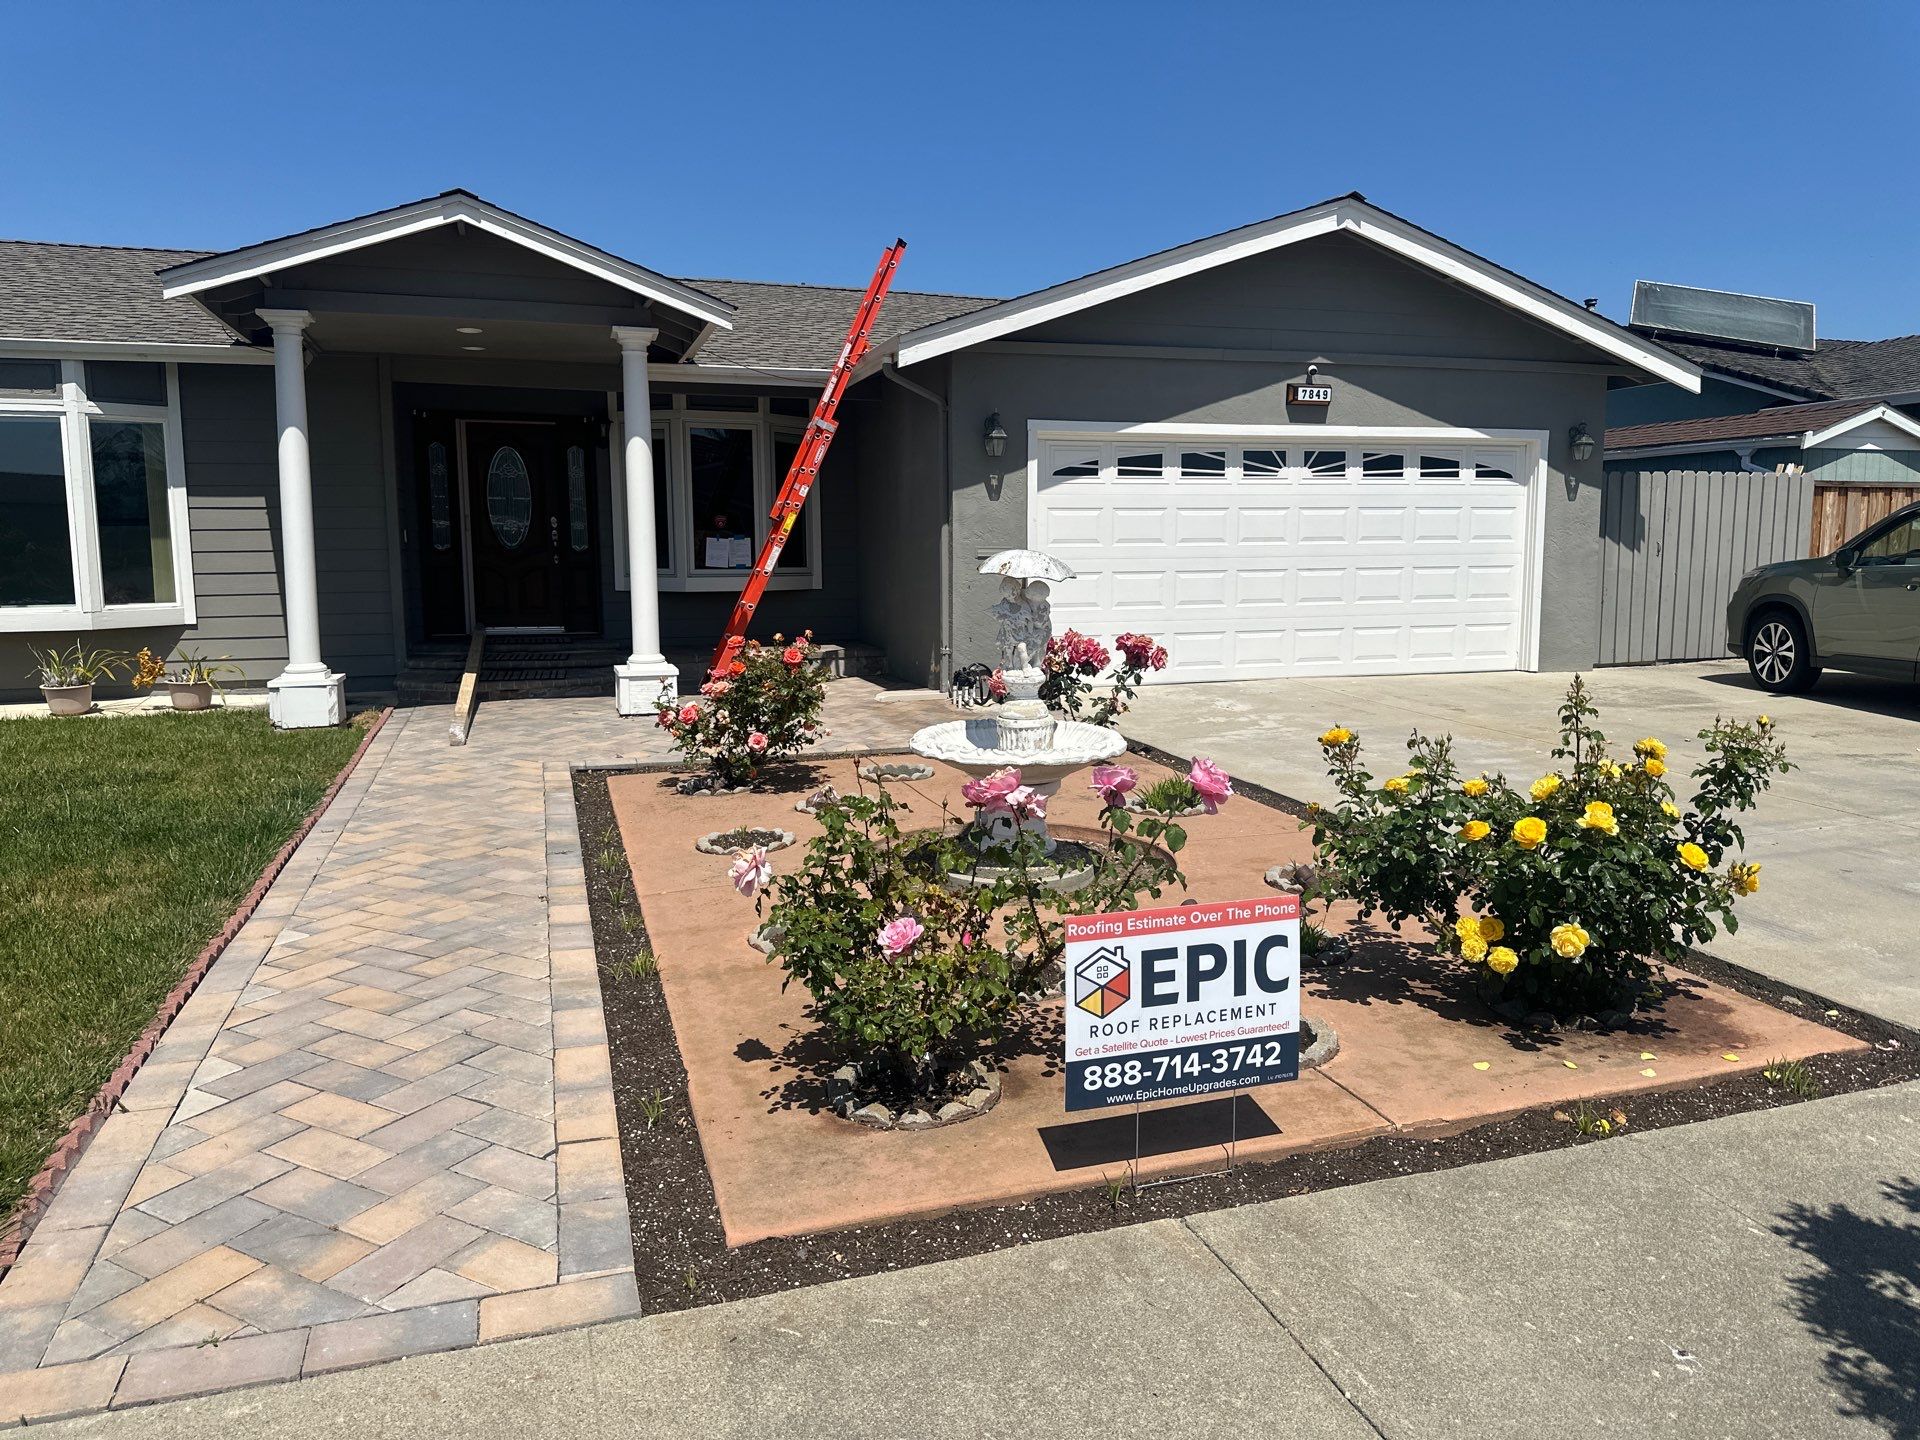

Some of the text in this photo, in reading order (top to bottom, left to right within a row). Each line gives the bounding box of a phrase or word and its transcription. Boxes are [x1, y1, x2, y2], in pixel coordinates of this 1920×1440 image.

[1301, 389, 1328, 400] 7849
[1067, 903, 1296, 937] Roofing Estimate Over The Phone
[1141, 934, 1290, 1008] EPIC
[1089, 1002, 1277, 1038] ROOF REPLACEMENT
[1074, 1046, 1092, 1057] Get
[1093, 1046, 1100, 1055] a
[1101, 1041, 1138, 1054] Satellite
[1139, 1037, 1169, 1049] Quote
[1175, 1032, 1207, 1044] Lowest
[1209, 1028, 1236, 1040] Prices
[1237, 1020, 1290, 1036] Guaranteed!
[1083, 1041, 1281, 1091] 888-714-3742
[1106, 1074, 1260, 1104] www.EpicHomeUpgrades.com
